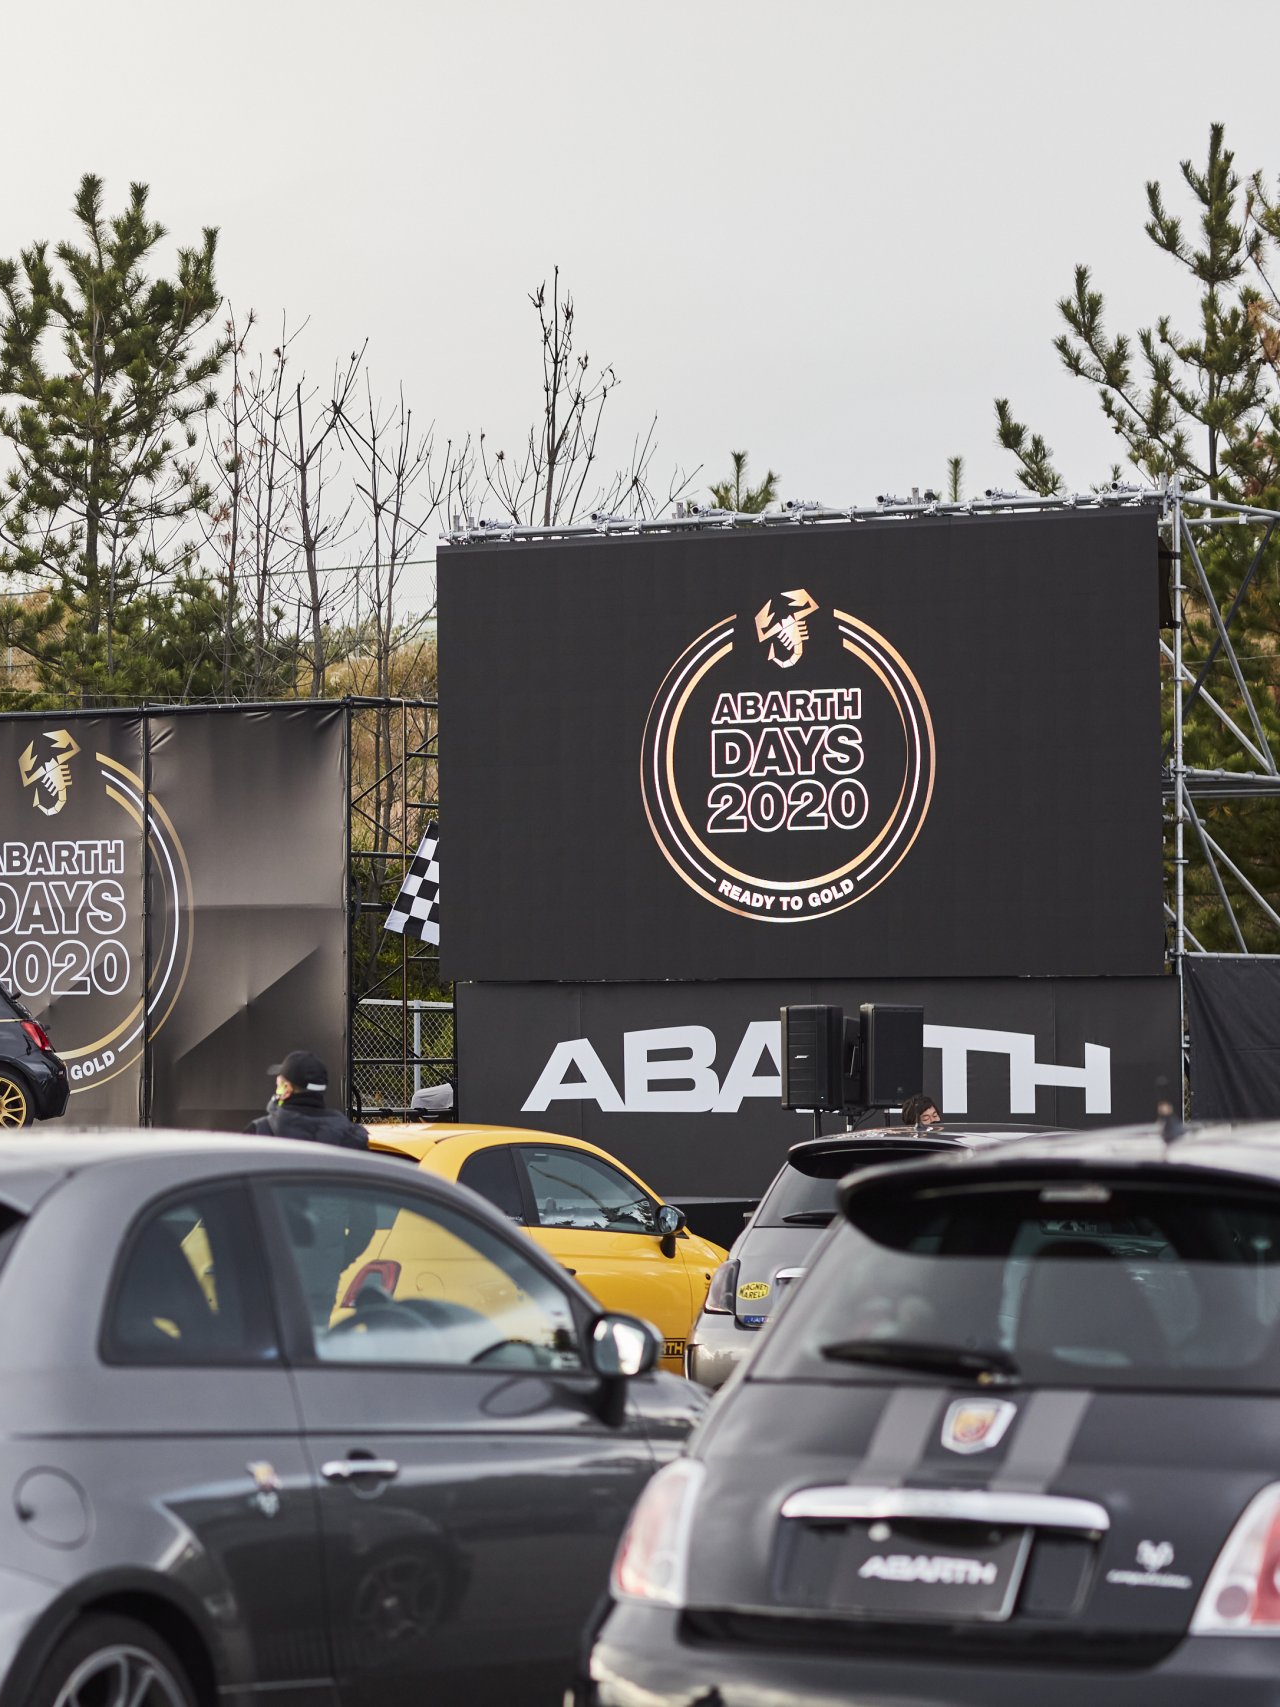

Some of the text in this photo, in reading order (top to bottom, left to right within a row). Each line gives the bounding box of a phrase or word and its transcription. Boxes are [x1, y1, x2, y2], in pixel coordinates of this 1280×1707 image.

[711, 688, 862, 724] ABARTH
[711, 724, 864, 778] DAYS
[707, 778, 869, 833] 2020
[717, 878, 855, 911] READY TO GOLD
[70, 1050, 116, 1081] GOLD
[520, 1021, 1111, 1114] ABATH
[857, 1554, 998, 1585] ABARTH
